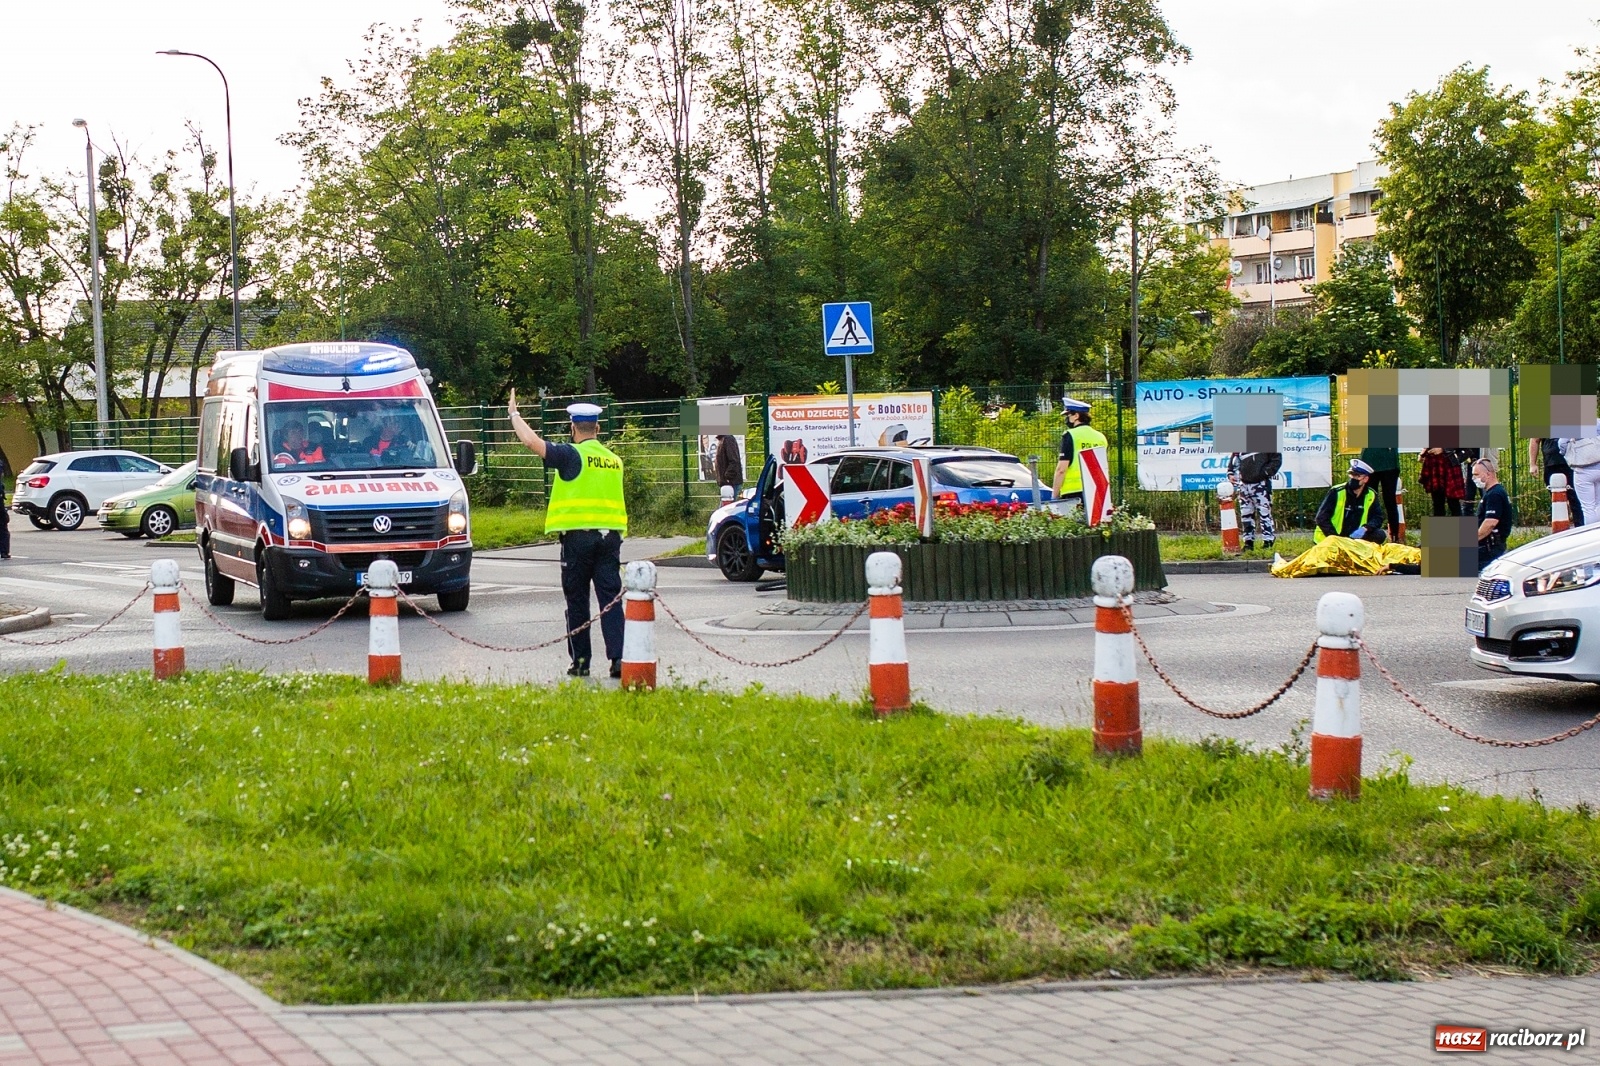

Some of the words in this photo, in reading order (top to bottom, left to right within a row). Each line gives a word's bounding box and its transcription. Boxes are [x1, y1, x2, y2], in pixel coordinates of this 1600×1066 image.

[310, 345, 360, 354] AMBULANS
[1143, 388, 1184, 402] AUTO
[775, 410, 805, 419] SALON
[807, 409, 849, 419] DZIECIĘC
[878, 403, 928, 415] BoboSklep
[804, 423, 847, 431] Starowiejska
[1155, 447, 1177, 455] Jana
[1179, 446, 1205, 454] Pawła
[587, 456, 620, 470] POLICJA
